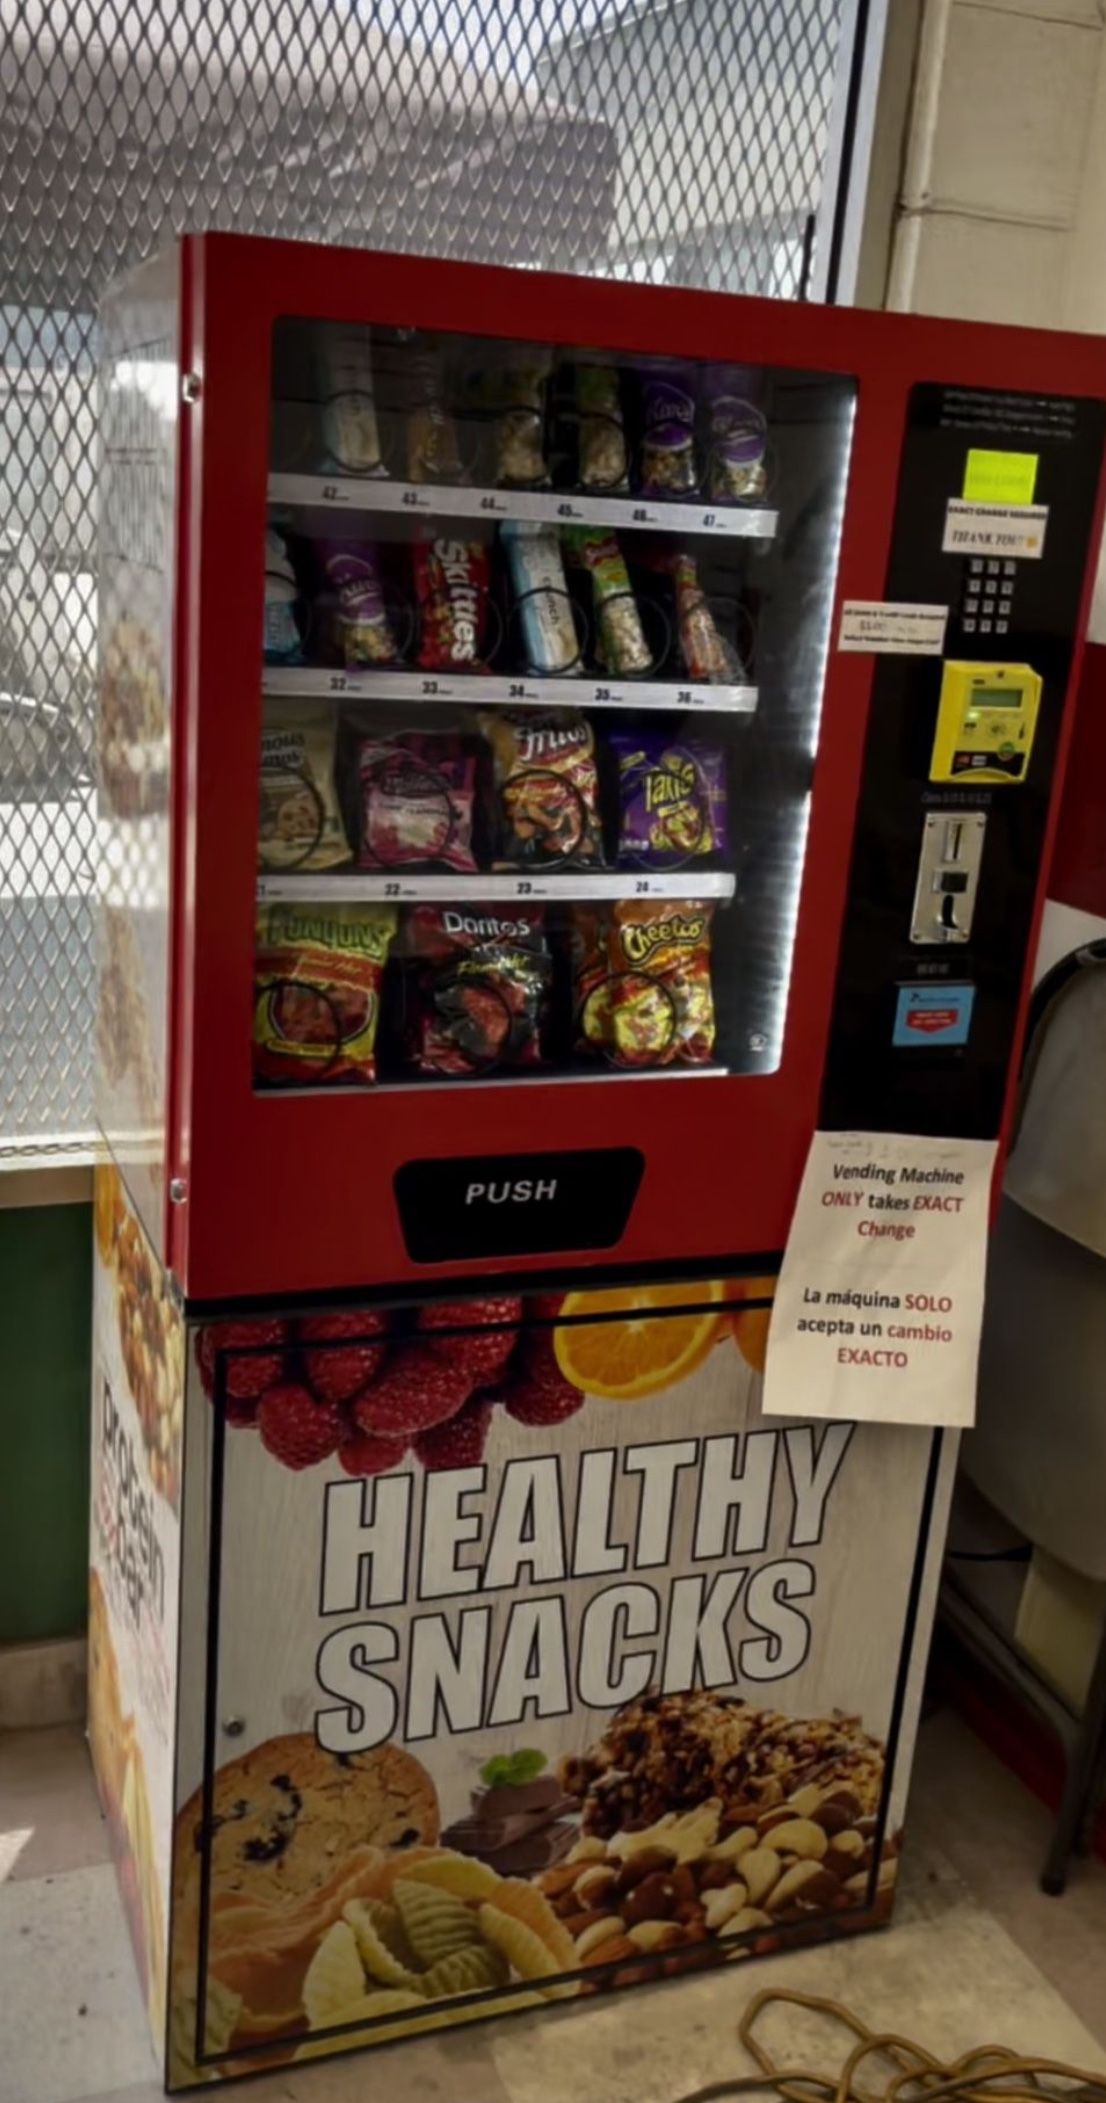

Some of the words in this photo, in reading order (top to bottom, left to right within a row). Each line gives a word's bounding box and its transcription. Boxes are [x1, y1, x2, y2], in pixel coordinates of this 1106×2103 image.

[322, 486, 338, 500] 42
[402, 492, 418, 506] 43
[480, 496, 496, 510] 44
[557, 504, 572, 517] 45
[632, 509, 648, 522] 46
[702, 514, 716, 527] 47
[952, 530, 992, 544] THANK
[434, 538, 479, 662] Skittles
[330, 677, 346, 690] 32
[422, 681, 438, 694] 33
[509, 685, 525, 698] 34
[595, 688, 610, 701] 35
[677, 691, 692, 704] 36
[384, 883, 400, 896] 22
[517, 882, 532, 895] 23
[636, 881, 649, 893] 24
[442, 911, 531, 938] Doritos
[621, 914, 705, 963] Cheetos
[833, 1163, 896, 1185] Vending
[900, 1167, 965, 1185] Machine
[465, 1179, 557, 1205] PUSH
[821, 1191, 864, 1208] ONLY
[868, 1193, 911, 1212] takes
[912, 1195, 965, 1213] EXACT
[857, 1220, 916, 1240] Change
[803, 1287, 821, 1304] La
[826, 1288, 900, 1310] máquina
[904, 1293, 953, 1313] SOLO
[797, 1317, 855, 1338] acepta
[859, 1322, 882, 1337] un
[887, 1321, 953, 1343] cambio
[837, 1347, 908, 1368] EXACTO
[318, 1419, 857, 1617] HEALTHY
[314, 1558, 816, 1756] SNACKS
